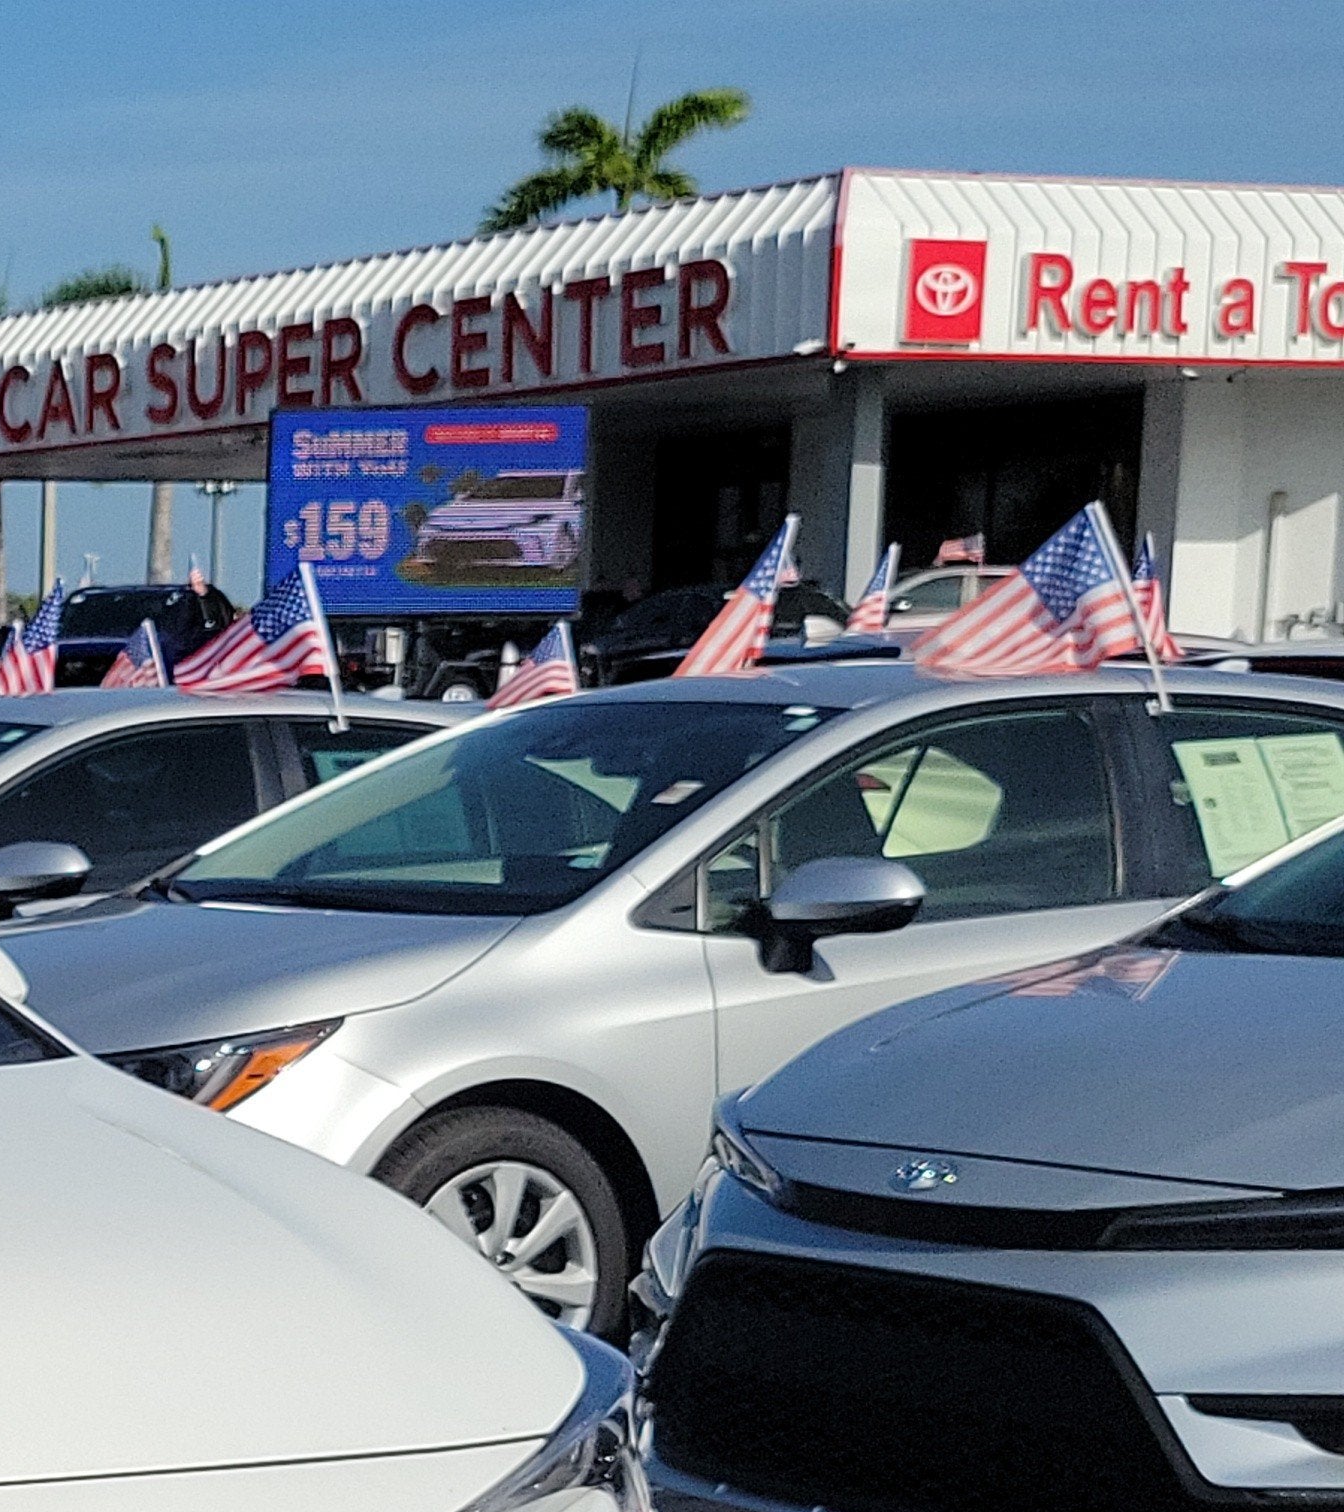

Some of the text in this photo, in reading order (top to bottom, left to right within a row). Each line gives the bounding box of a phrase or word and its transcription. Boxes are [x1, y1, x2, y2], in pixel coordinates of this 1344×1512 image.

[145, 316, 364, 423] SUPER
[394, 259, 732, 395] CENTER
[1025, 252, 1191, 338] Rent
[1218, 277, 1256, 338] a
